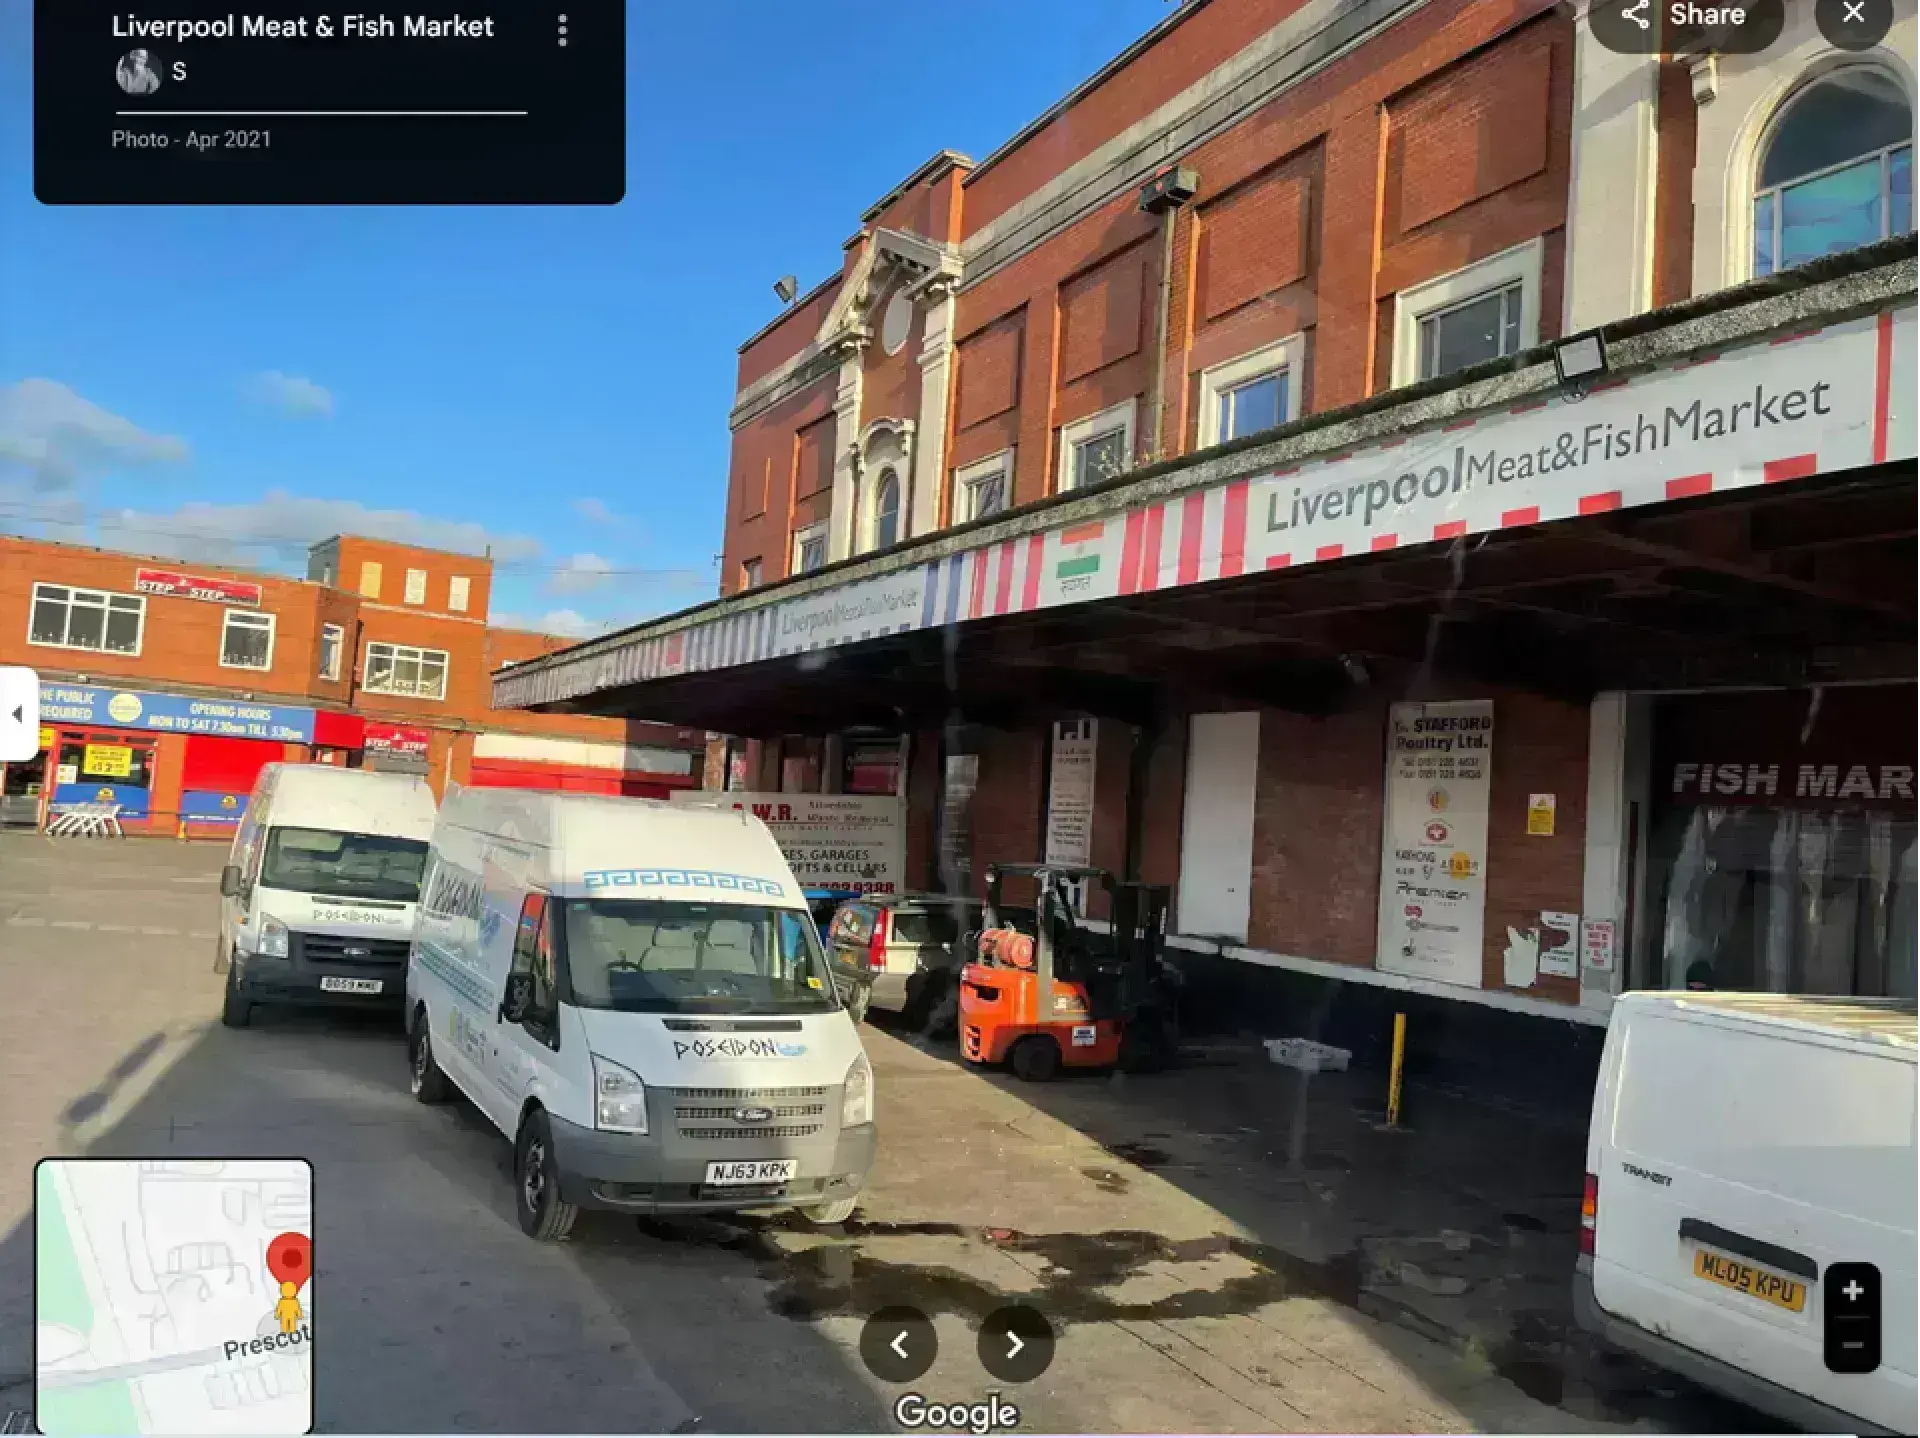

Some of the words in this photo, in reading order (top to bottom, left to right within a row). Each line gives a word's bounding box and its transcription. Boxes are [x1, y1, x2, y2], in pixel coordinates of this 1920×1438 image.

[190, 702, 235, 718] OPENING
[237, 706, 272, 721] HOURS
[175, 717, 189, 728] TO
[192, 718, 211, 730] SAT
[1413, 716, 1491, 734] STAFFORD
[1396, 735, 1453, 752] Poultry
[1457, 733, 1489, 750] Ltd.
[1672, 763, 1780, 796] FISH
[783, 850, 808, 862] SES,
[810, 850, 869, 861] GARAGES
[789, 863, 822, 873] OFTS
[673, 1037, 778, 1060] POSEIDON
[713, 1163, 756, 1180] NJ63
[759, 1161, 789, 1178] KPK
[1700, 1253, 1752, 1290] ML05
[1754, 1271, 1796, 1303] KPU
